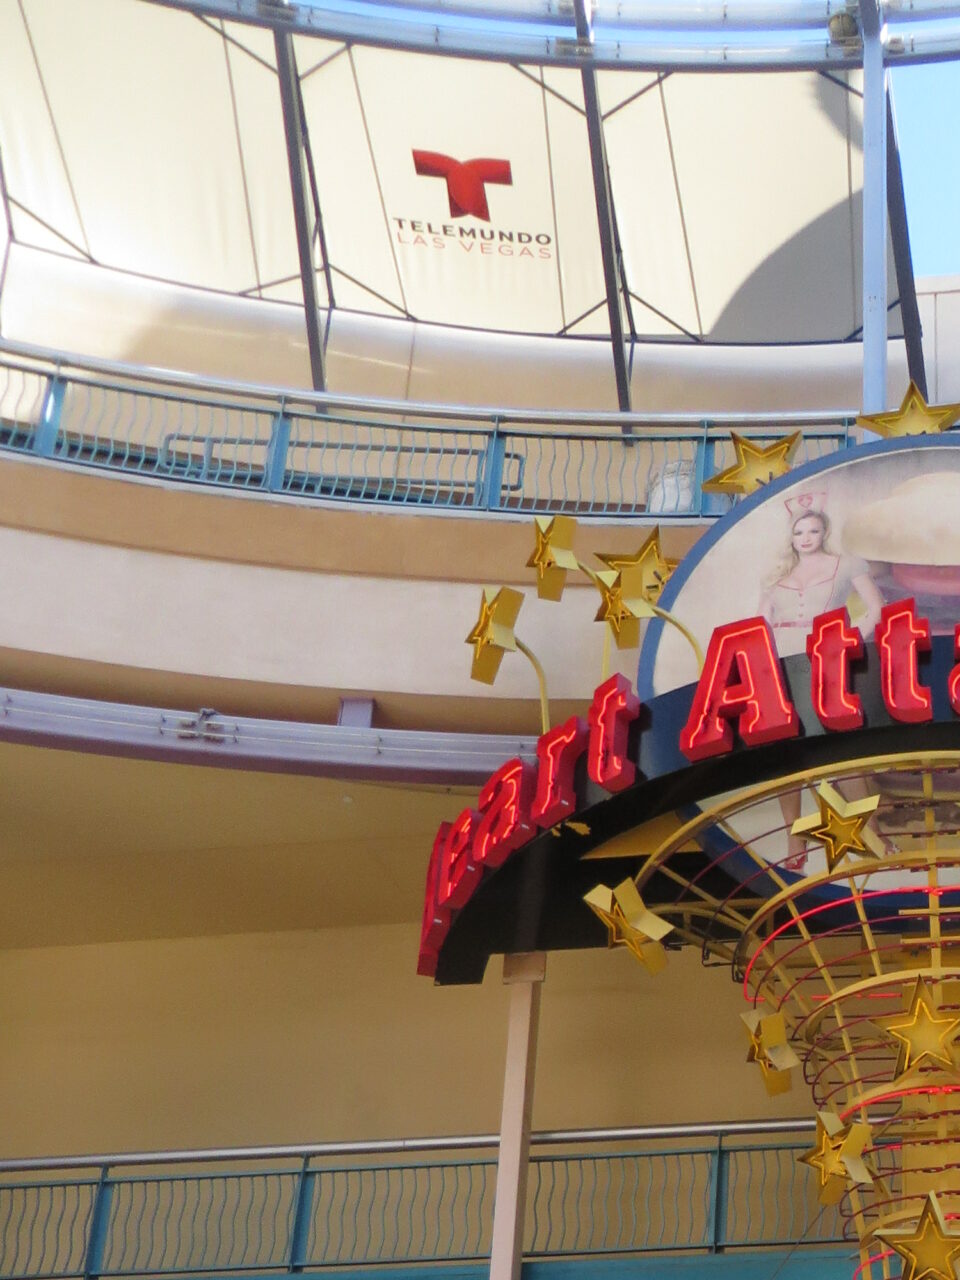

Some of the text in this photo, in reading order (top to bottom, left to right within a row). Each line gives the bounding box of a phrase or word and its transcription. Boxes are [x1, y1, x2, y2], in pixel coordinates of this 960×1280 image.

[393, 217, 552, 245] TELEMUNDO
[397, 232, 552, 259] LAS VEGAS
